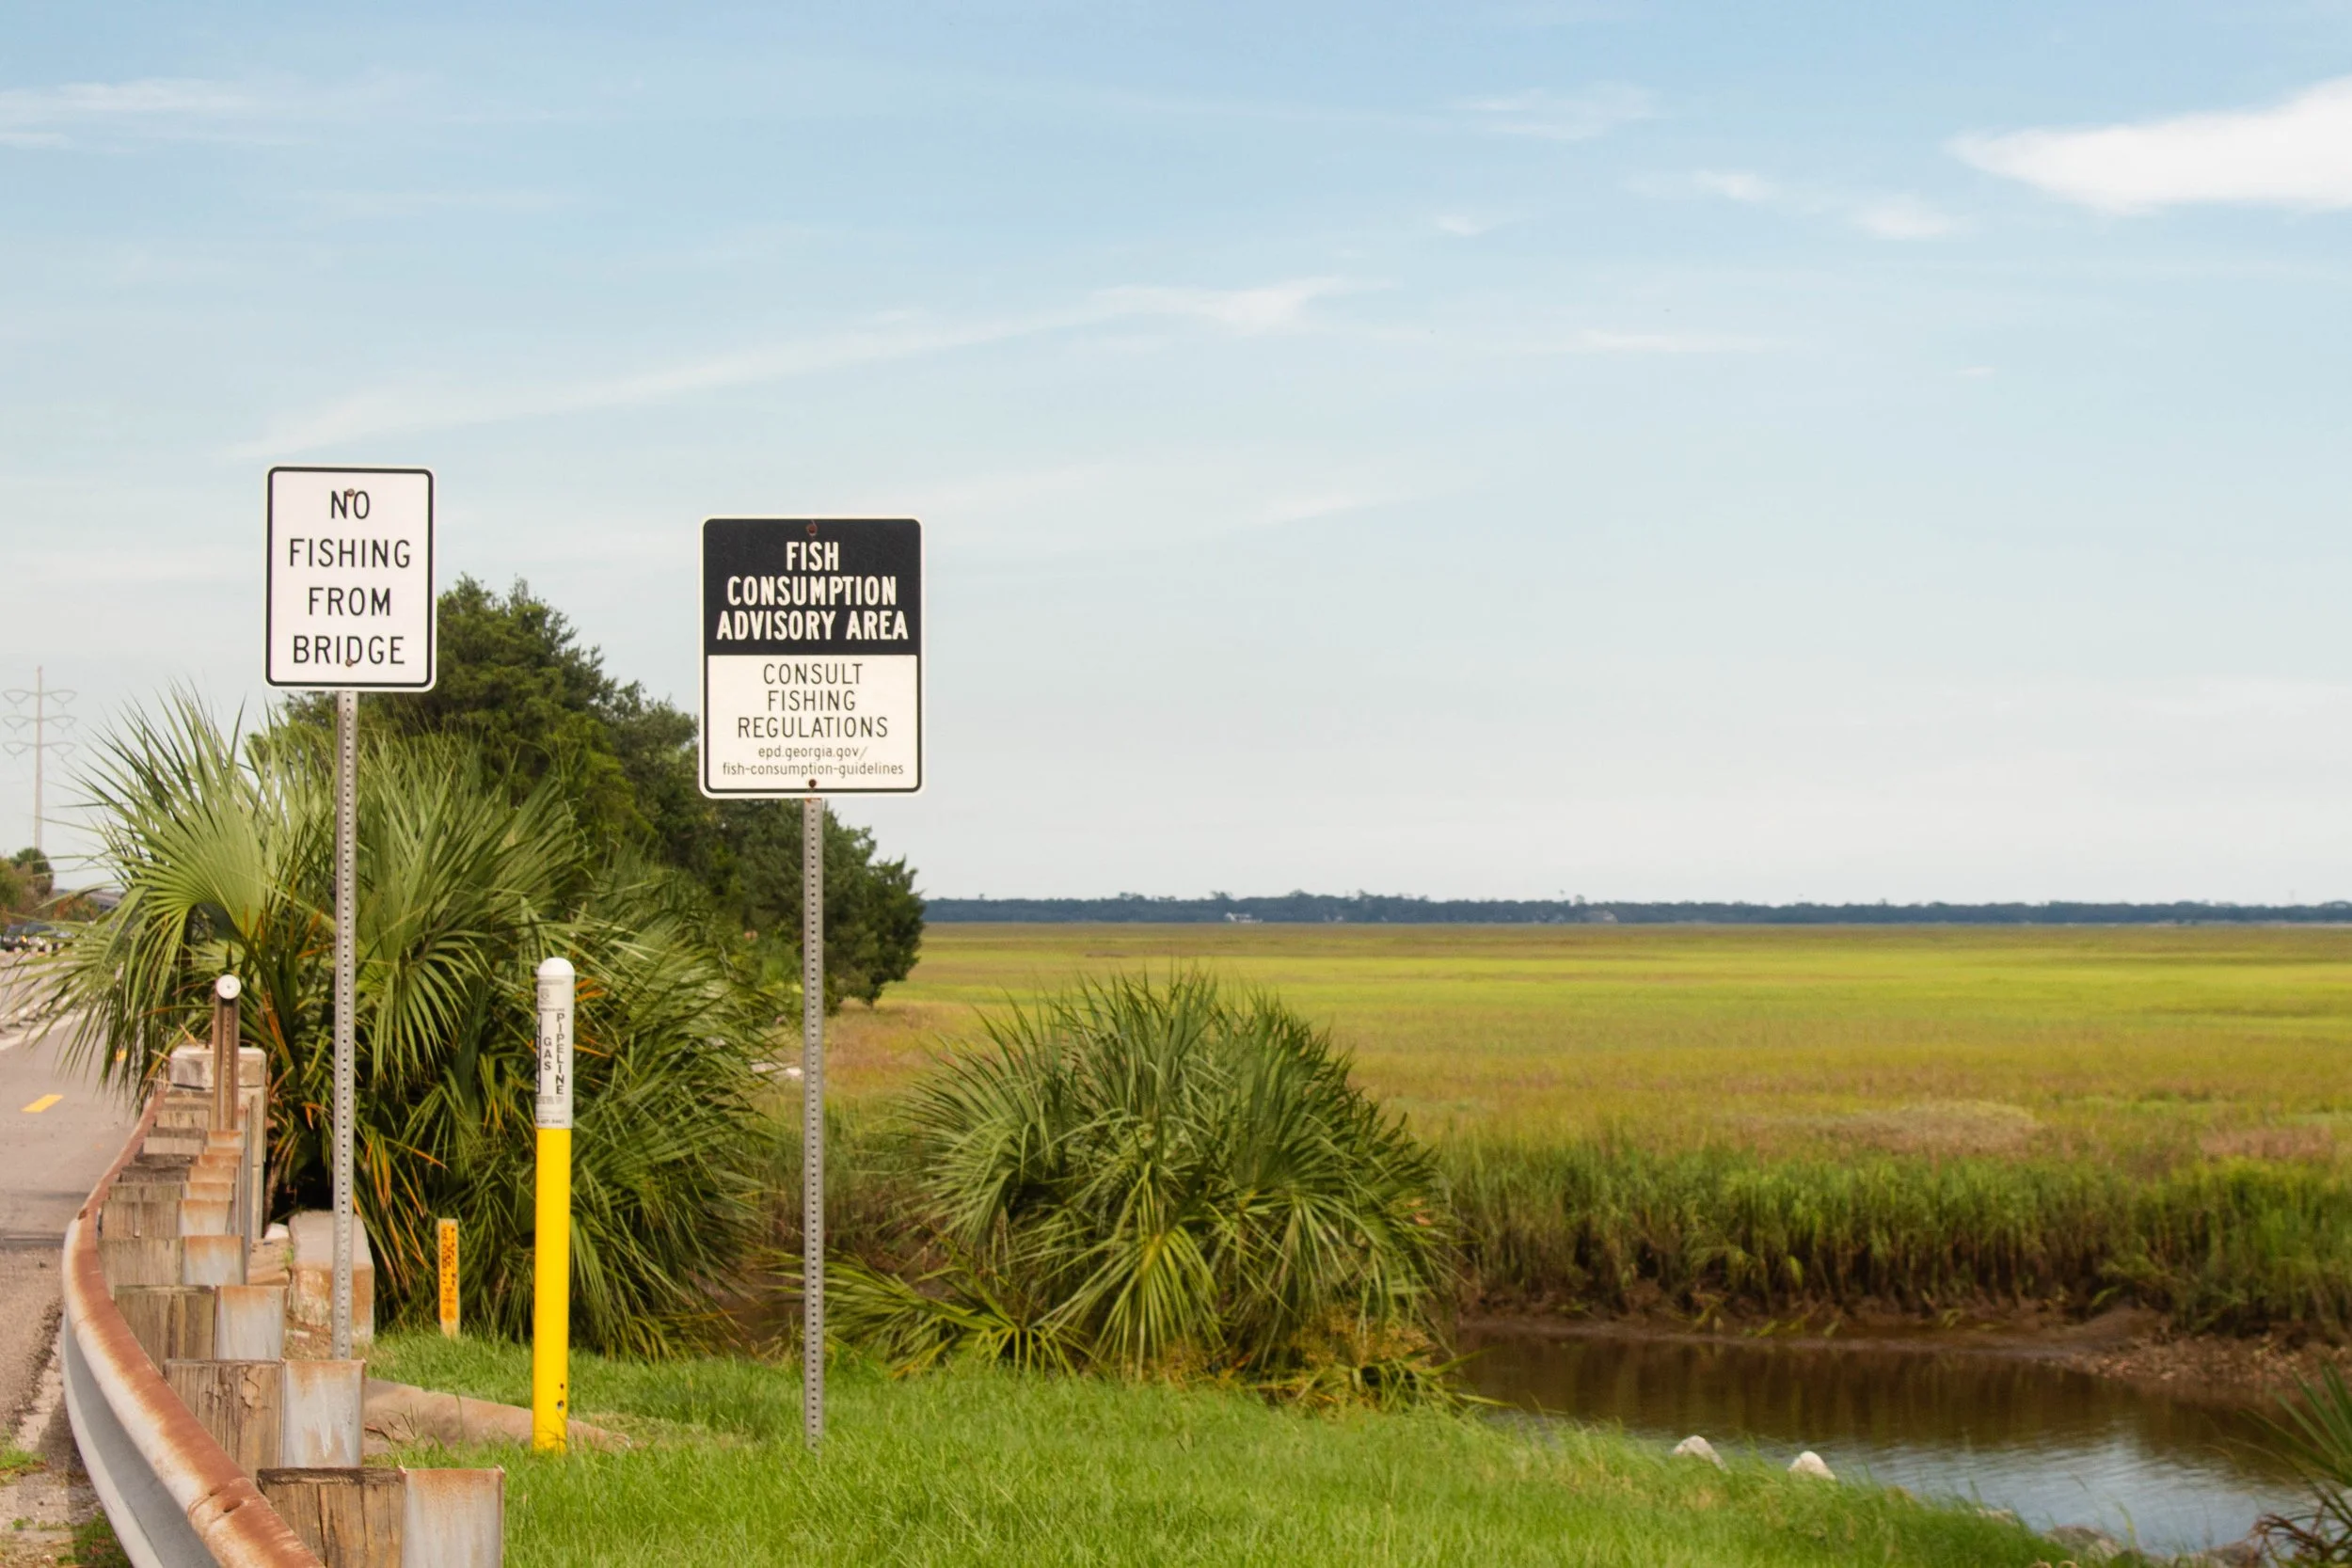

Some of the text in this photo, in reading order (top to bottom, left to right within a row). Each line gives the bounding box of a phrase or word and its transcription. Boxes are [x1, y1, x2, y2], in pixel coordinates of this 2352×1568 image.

[330, 489, 370, 519] NO
[289, 538, 410, 568] FISHING
[787, 541, 839, 571] FISH
[309, 587, 390, 616] FROM
[726, 576, 897, 606] CONSUMPTION
[716, 610, 909, 640] ADVISORY AREA
[294, 635, 405, 664] BRIDGE
[763, 663, 863, 685] CONSULT
[768, 689, 856, 711] FISHING
[738, 717, 888, 738] REGULATIONS
[758, 745, 867, 760] epd.georgia.gov/
[723, 762, 904, 778] fish-consumption-guidelines
[544, 1037, 552, 1071] GAS
[556, 1013, 564, 1094] PIPELINE
